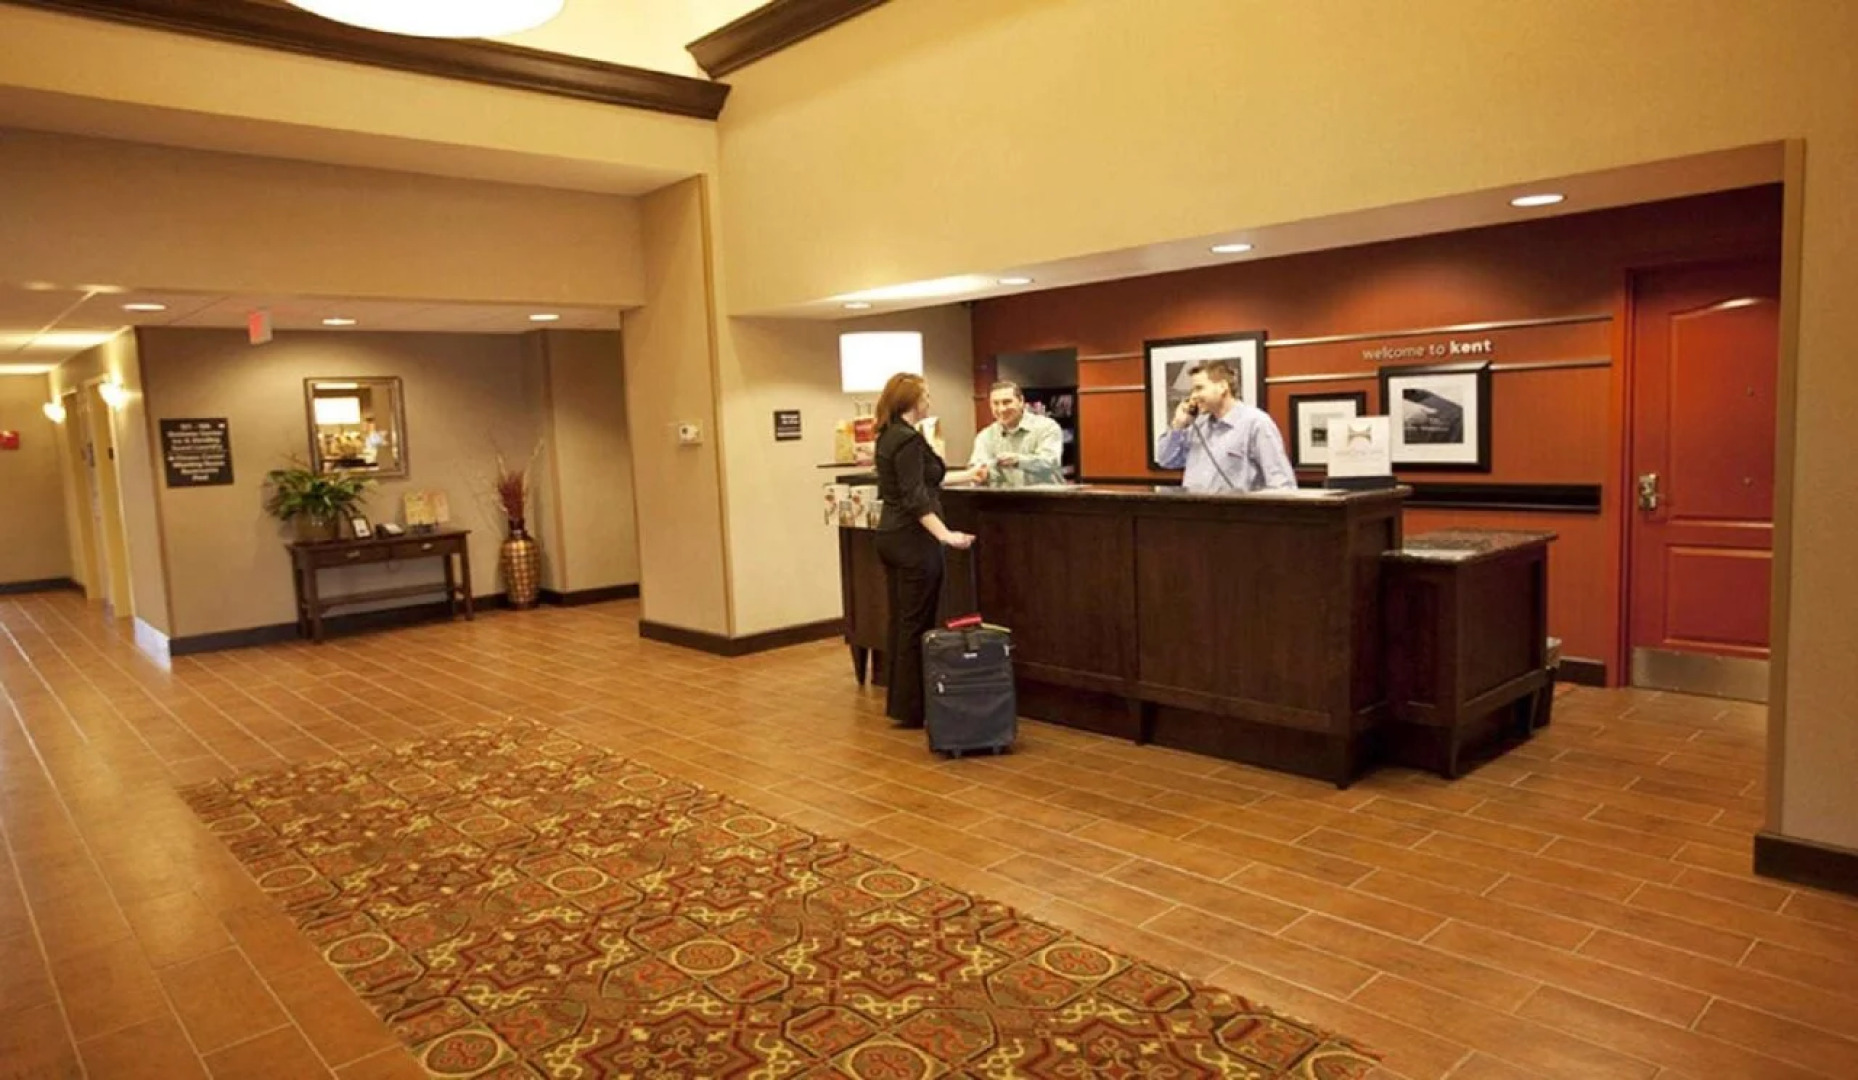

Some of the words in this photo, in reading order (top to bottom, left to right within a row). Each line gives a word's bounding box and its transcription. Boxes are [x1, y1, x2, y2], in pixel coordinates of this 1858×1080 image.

[1362, 345, 1425, 360] welcome
[1429, 343, 1446, 355] to
[1450, 338, 1492, 354] kent
